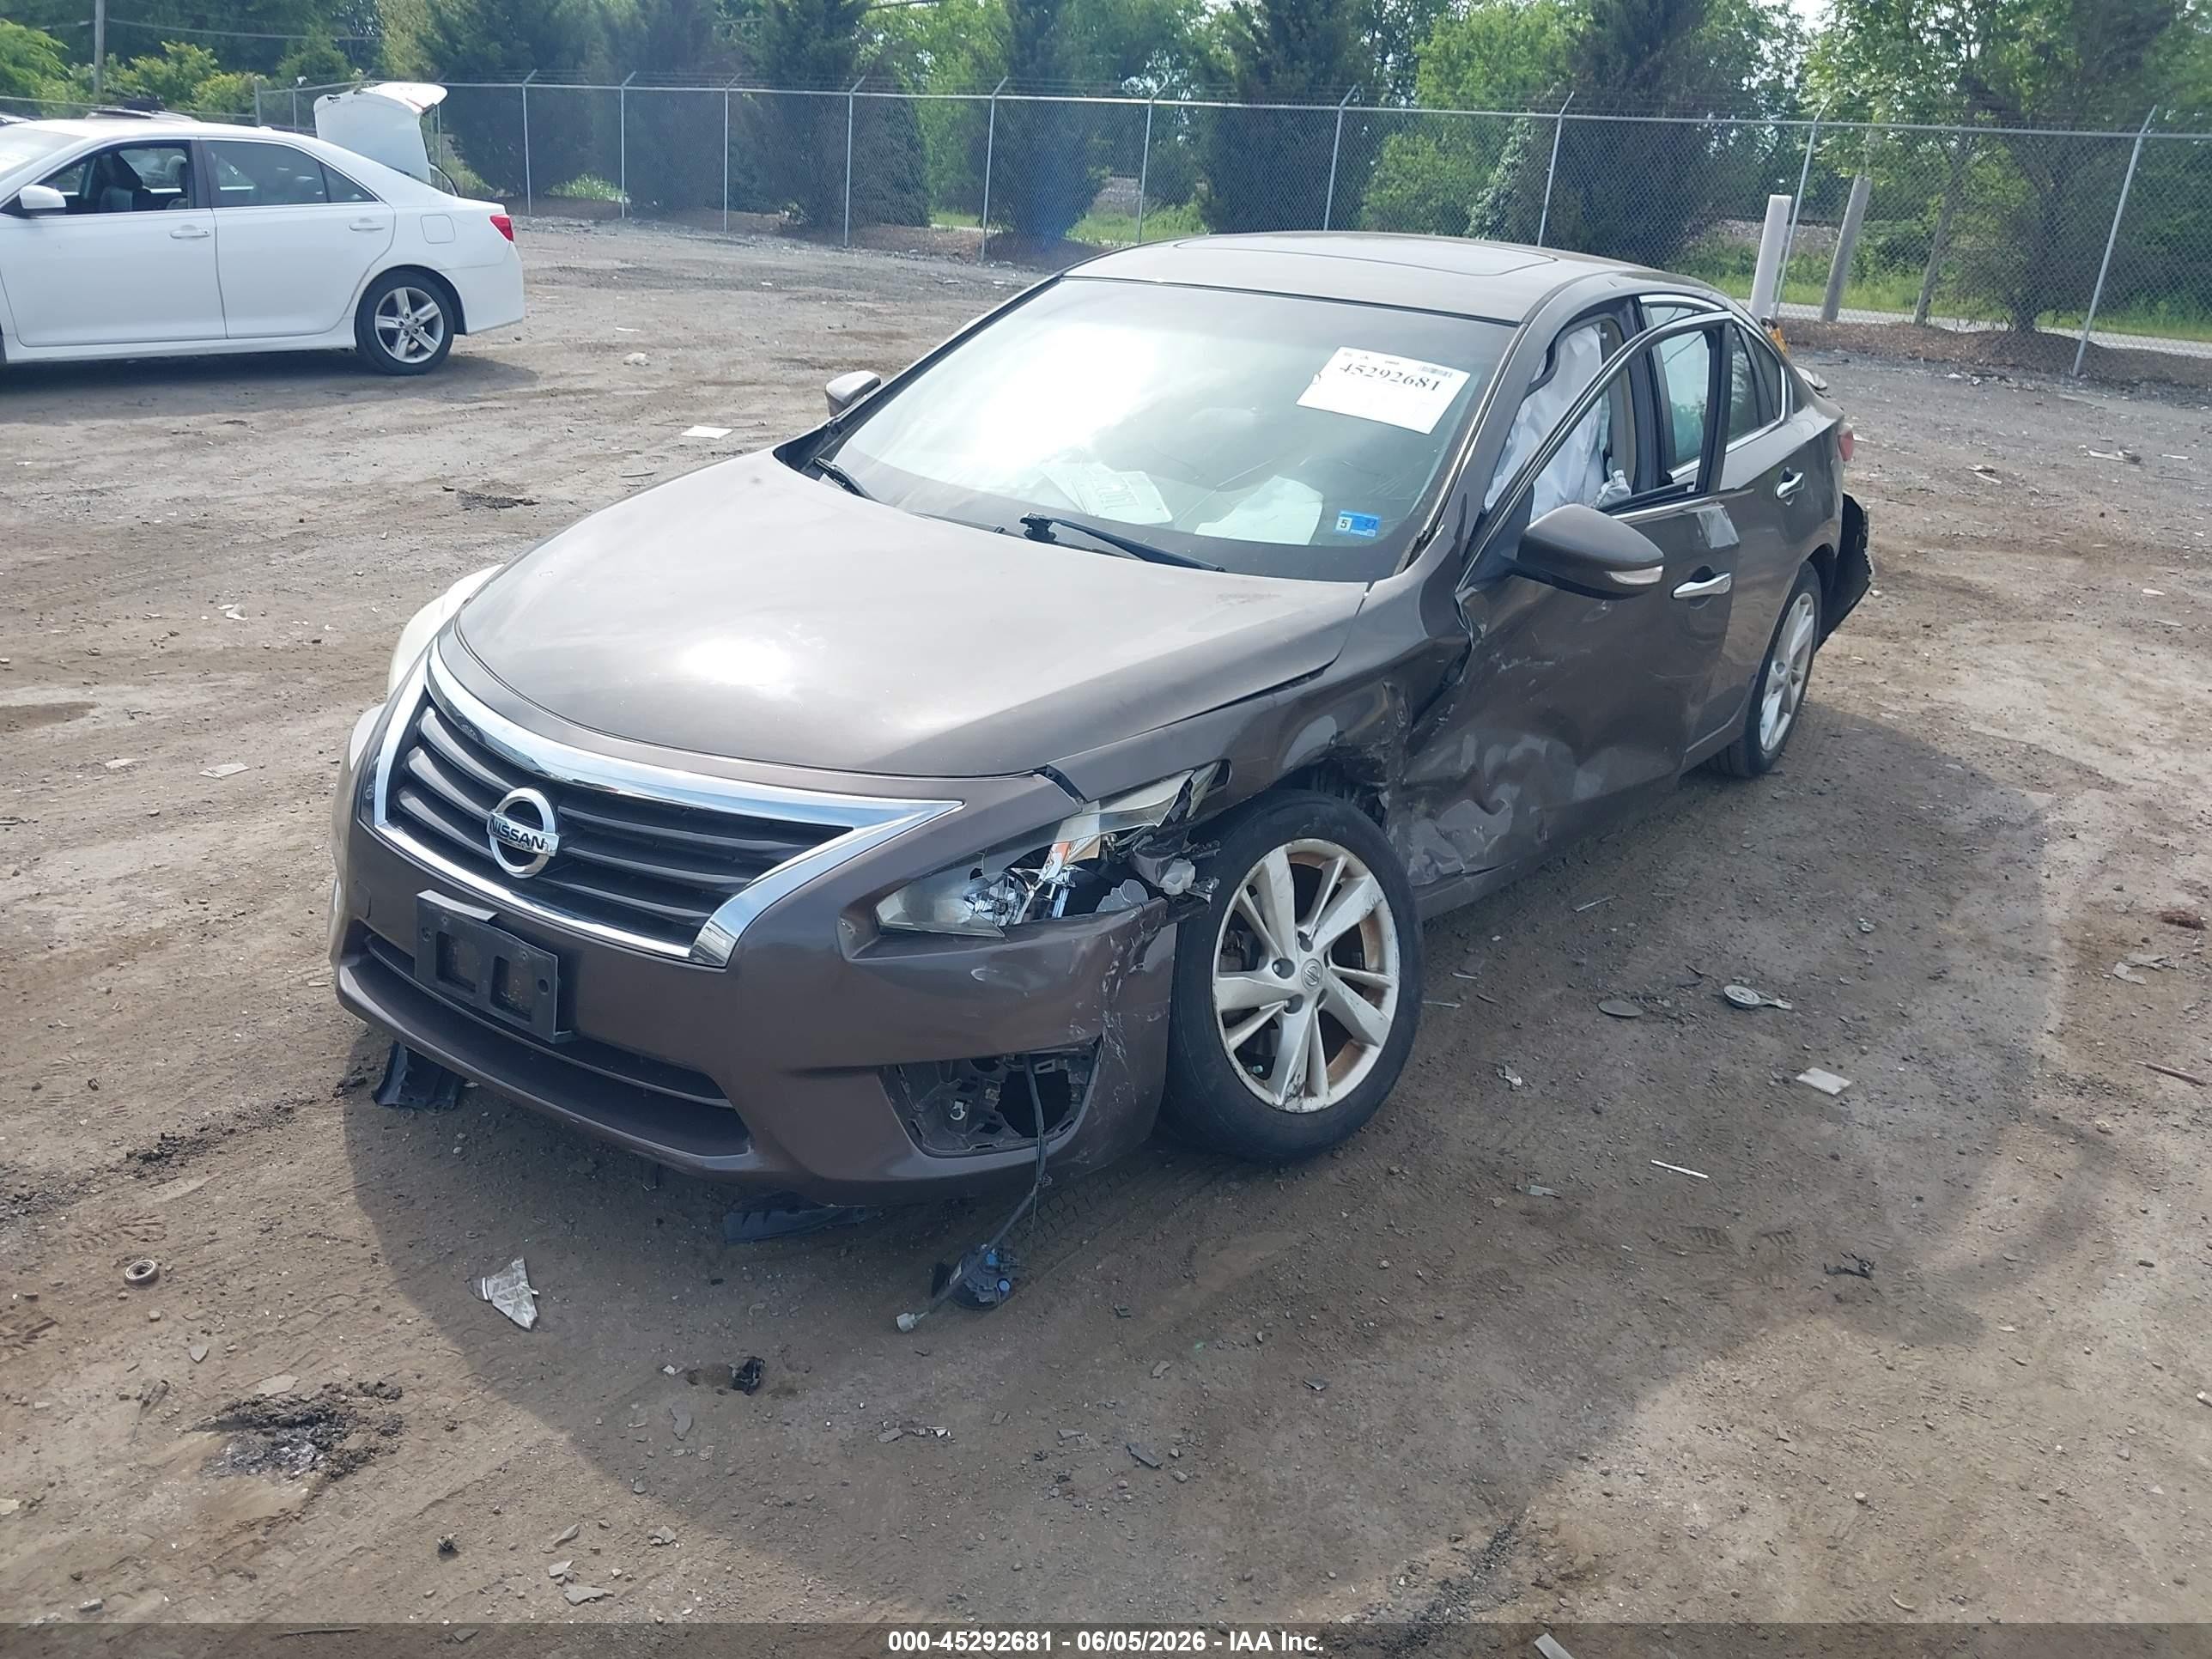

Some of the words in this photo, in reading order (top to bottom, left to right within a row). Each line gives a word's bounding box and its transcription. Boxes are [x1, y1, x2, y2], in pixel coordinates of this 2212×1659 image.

[1340, 362, 1441, 391] 45292681
[1340, 519, 1347, 529] 5
[489, 818, 545, 850] NISSAN
